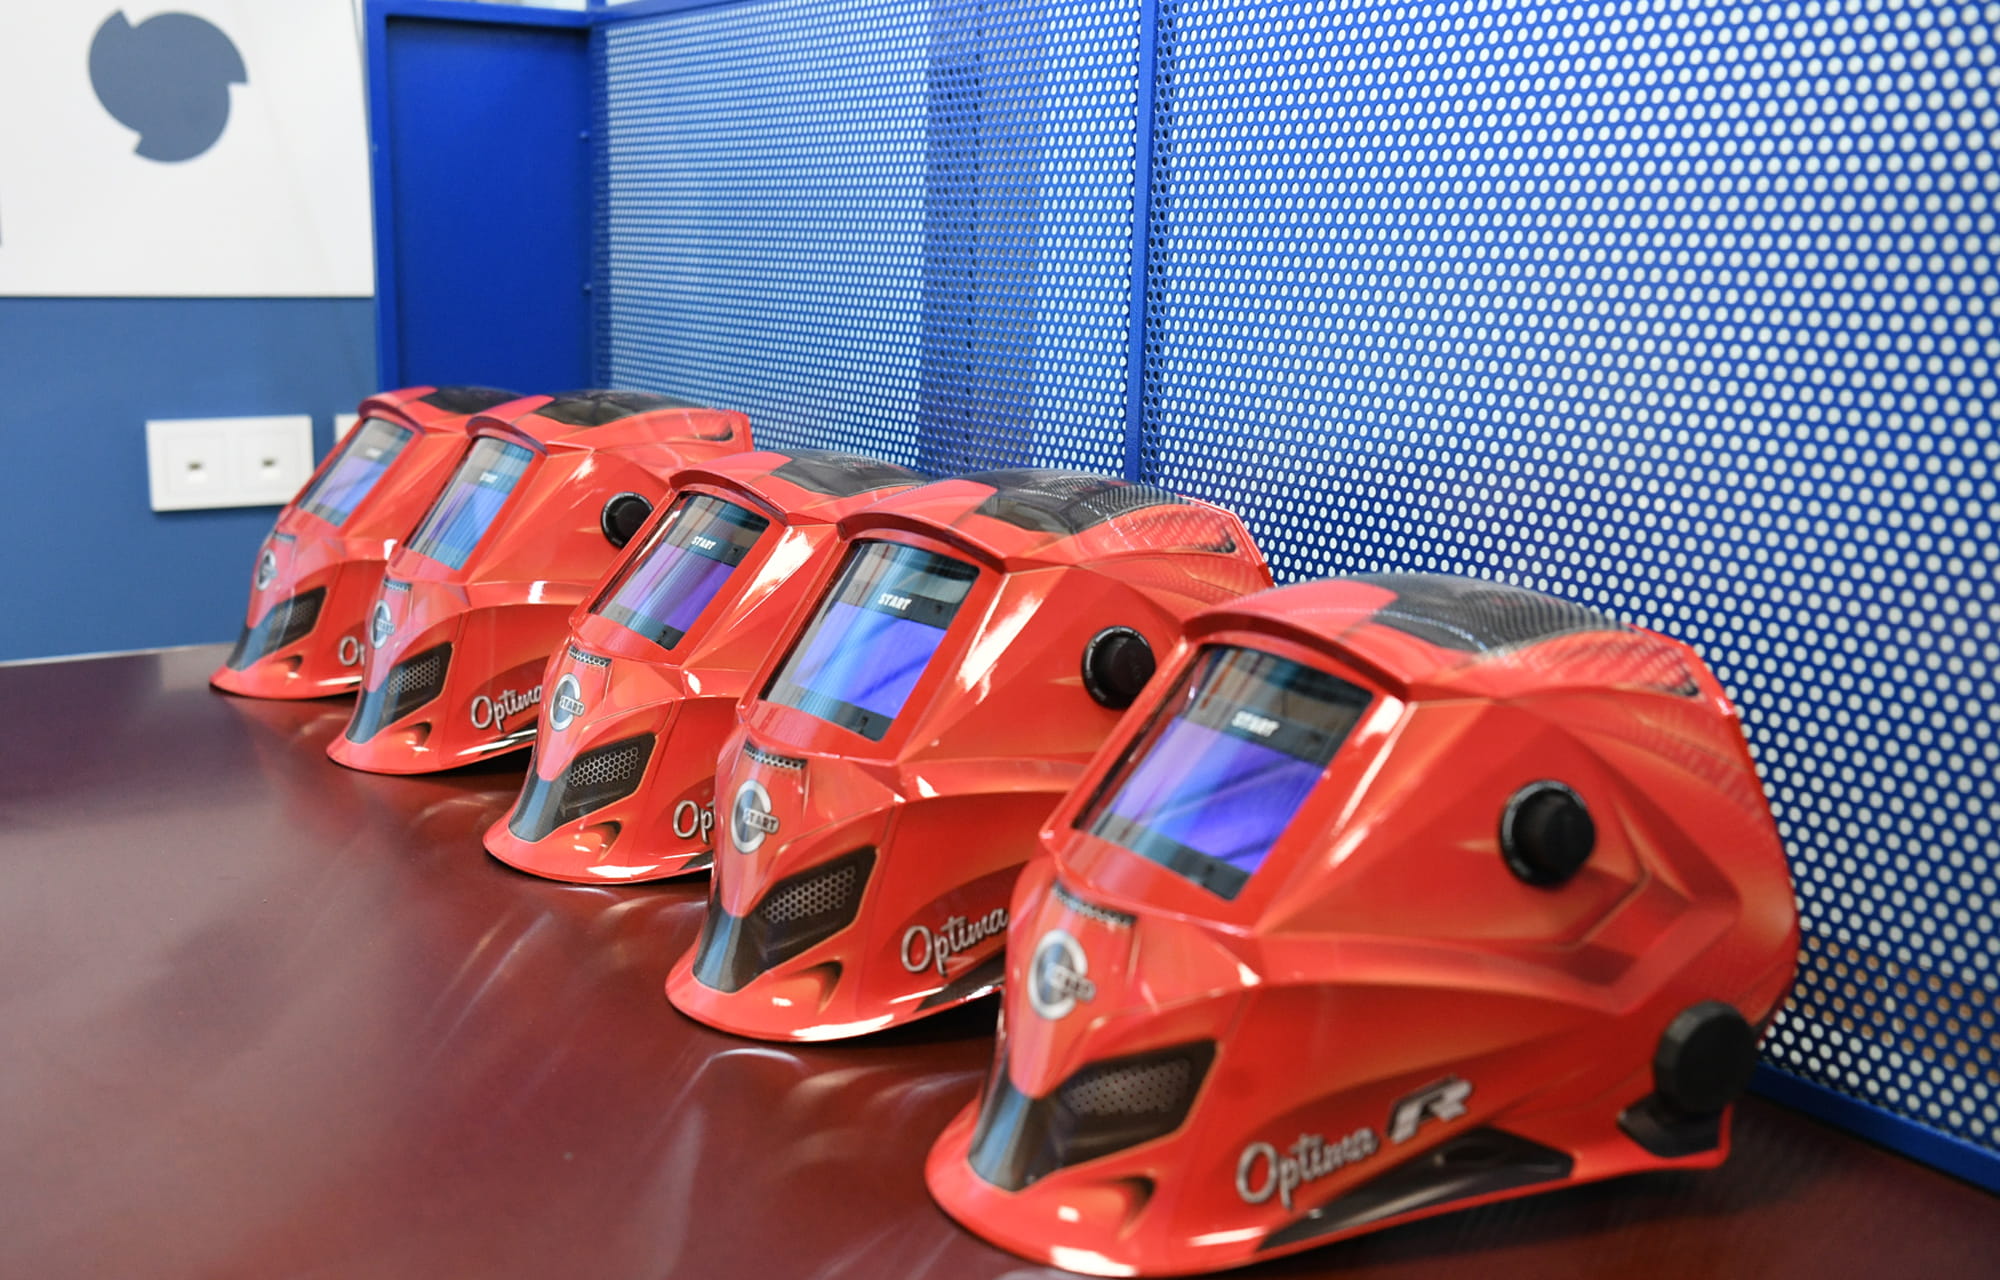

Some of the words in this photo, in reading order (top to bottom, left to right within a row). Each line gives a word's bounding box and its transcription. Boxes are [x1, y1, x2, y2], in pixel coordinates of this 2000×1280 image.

[878, 592, 913, 611] START
[559, 696, 585, 716] START
[743, 808, 779, 834] START
[900, 907, 1009, 976] Optima
[1235, 1127, 1380, 1210] Optima
[1387, 1075, 1473, 1144] R
